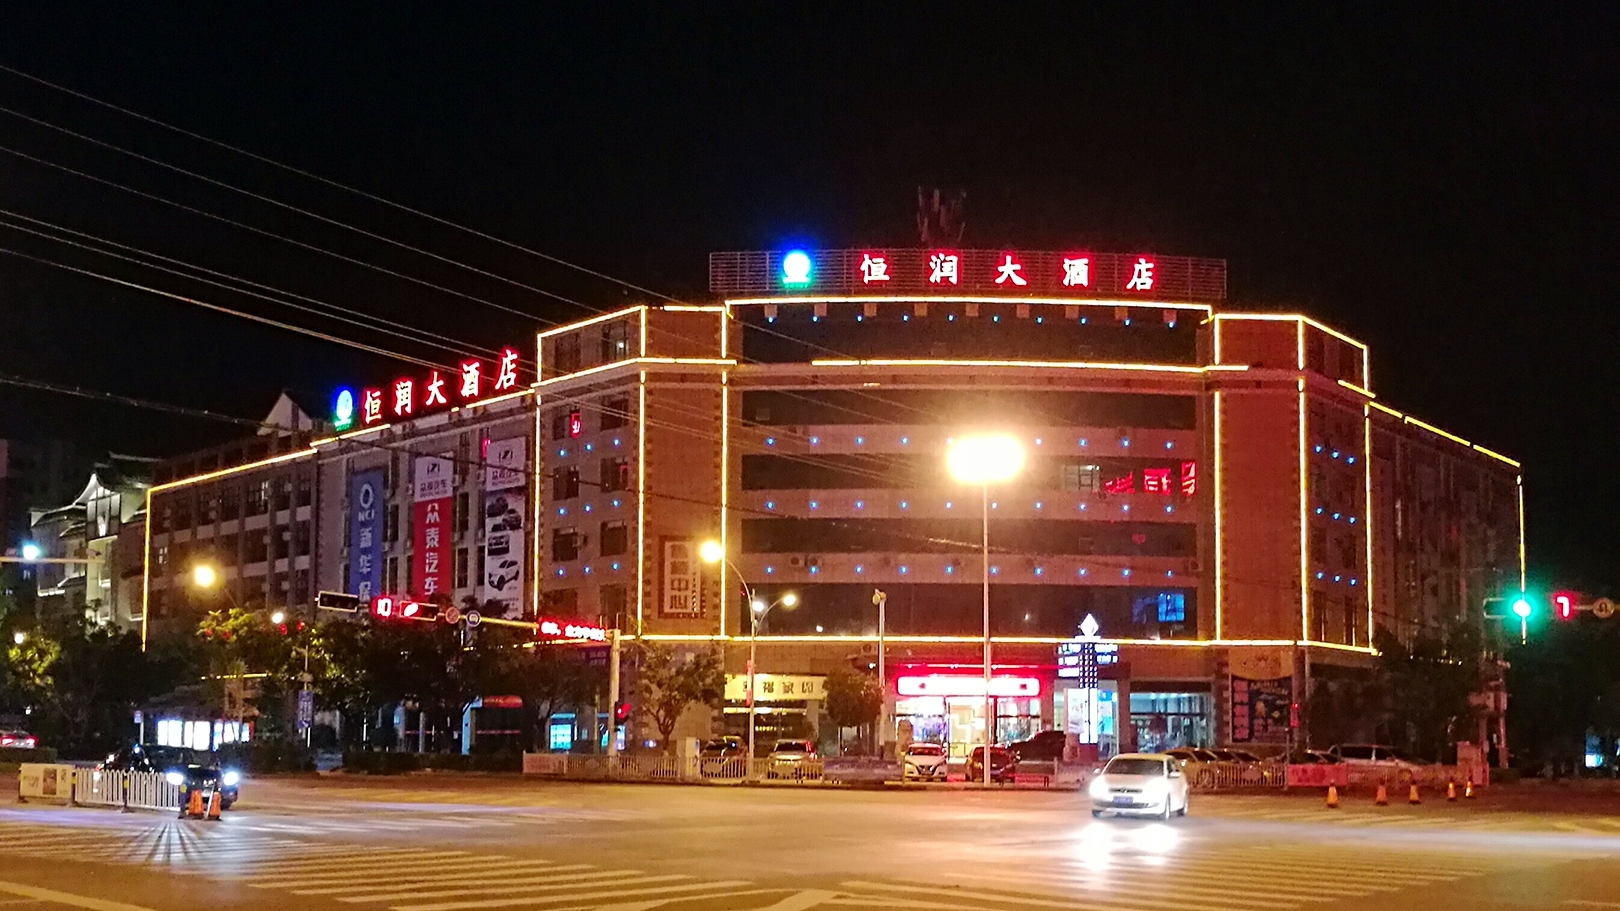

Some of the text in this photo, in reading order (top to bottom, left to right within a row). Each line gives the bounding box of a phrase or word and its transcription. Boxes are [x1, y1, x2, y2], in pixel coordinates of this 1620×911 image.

[861, 253, 1154, 291] 恒润大酒店
[364, 349, 517, 424] 恒润大酒店
[358, 509, 375, 522] NCI
[424, 502, 440, 595] 众泰汽车
[1556, 596, 1570, 617] 7
